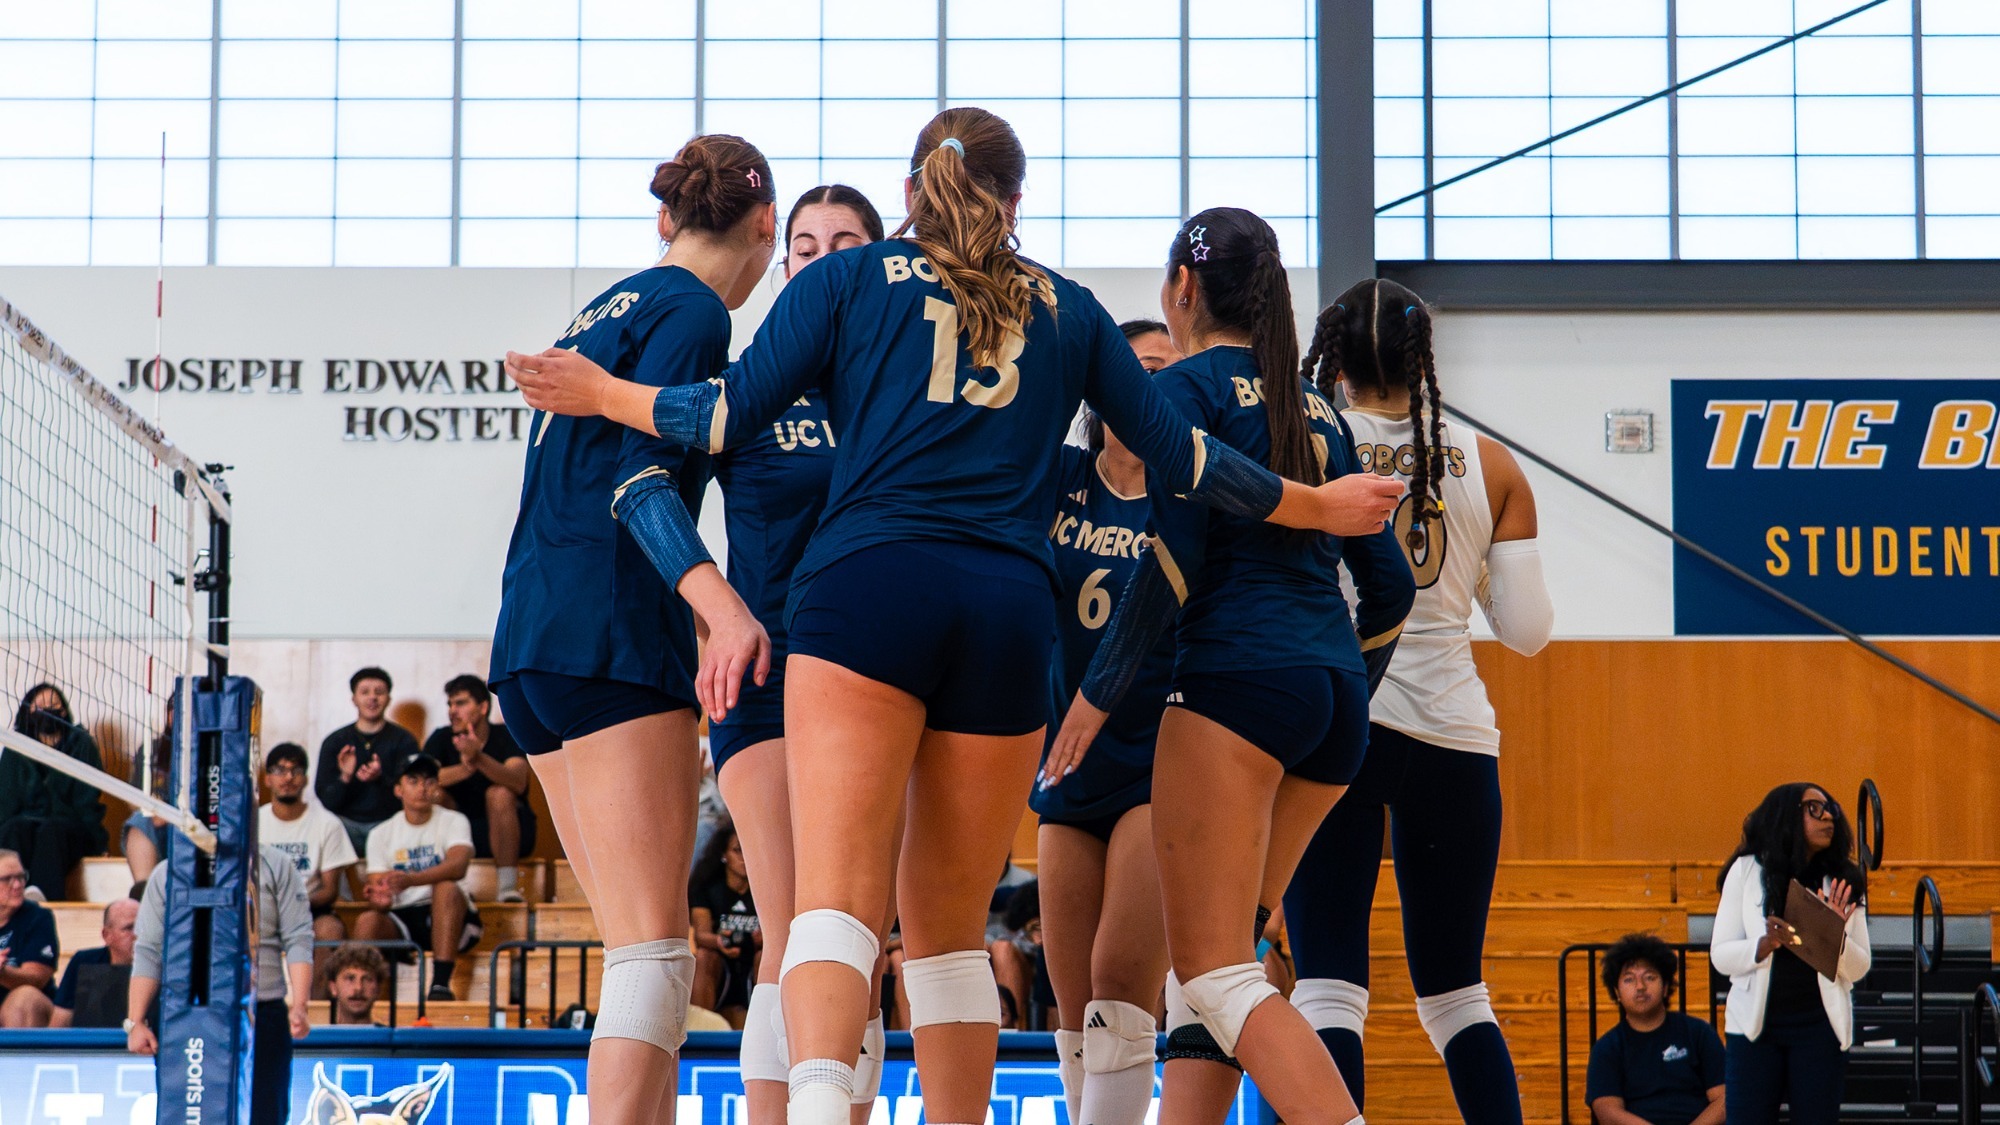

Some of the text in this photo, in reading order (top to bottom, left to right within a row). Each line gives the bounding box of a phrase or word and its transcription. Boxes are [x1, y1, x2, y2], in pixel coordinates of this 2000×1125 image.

[118, 358, 303, 394] JOSEPH
[923, 295, 1025, 409] 13
[343, 406, 530, 442] HOSTET
[773, 419, 821, 451] UC
[1704, 399, 2000, 470] THE B
[1765, 526, 2000, 577] STUDENT
[1077, 568, 1112, 630] 6
[184, 1037, 205, 1105] sports
